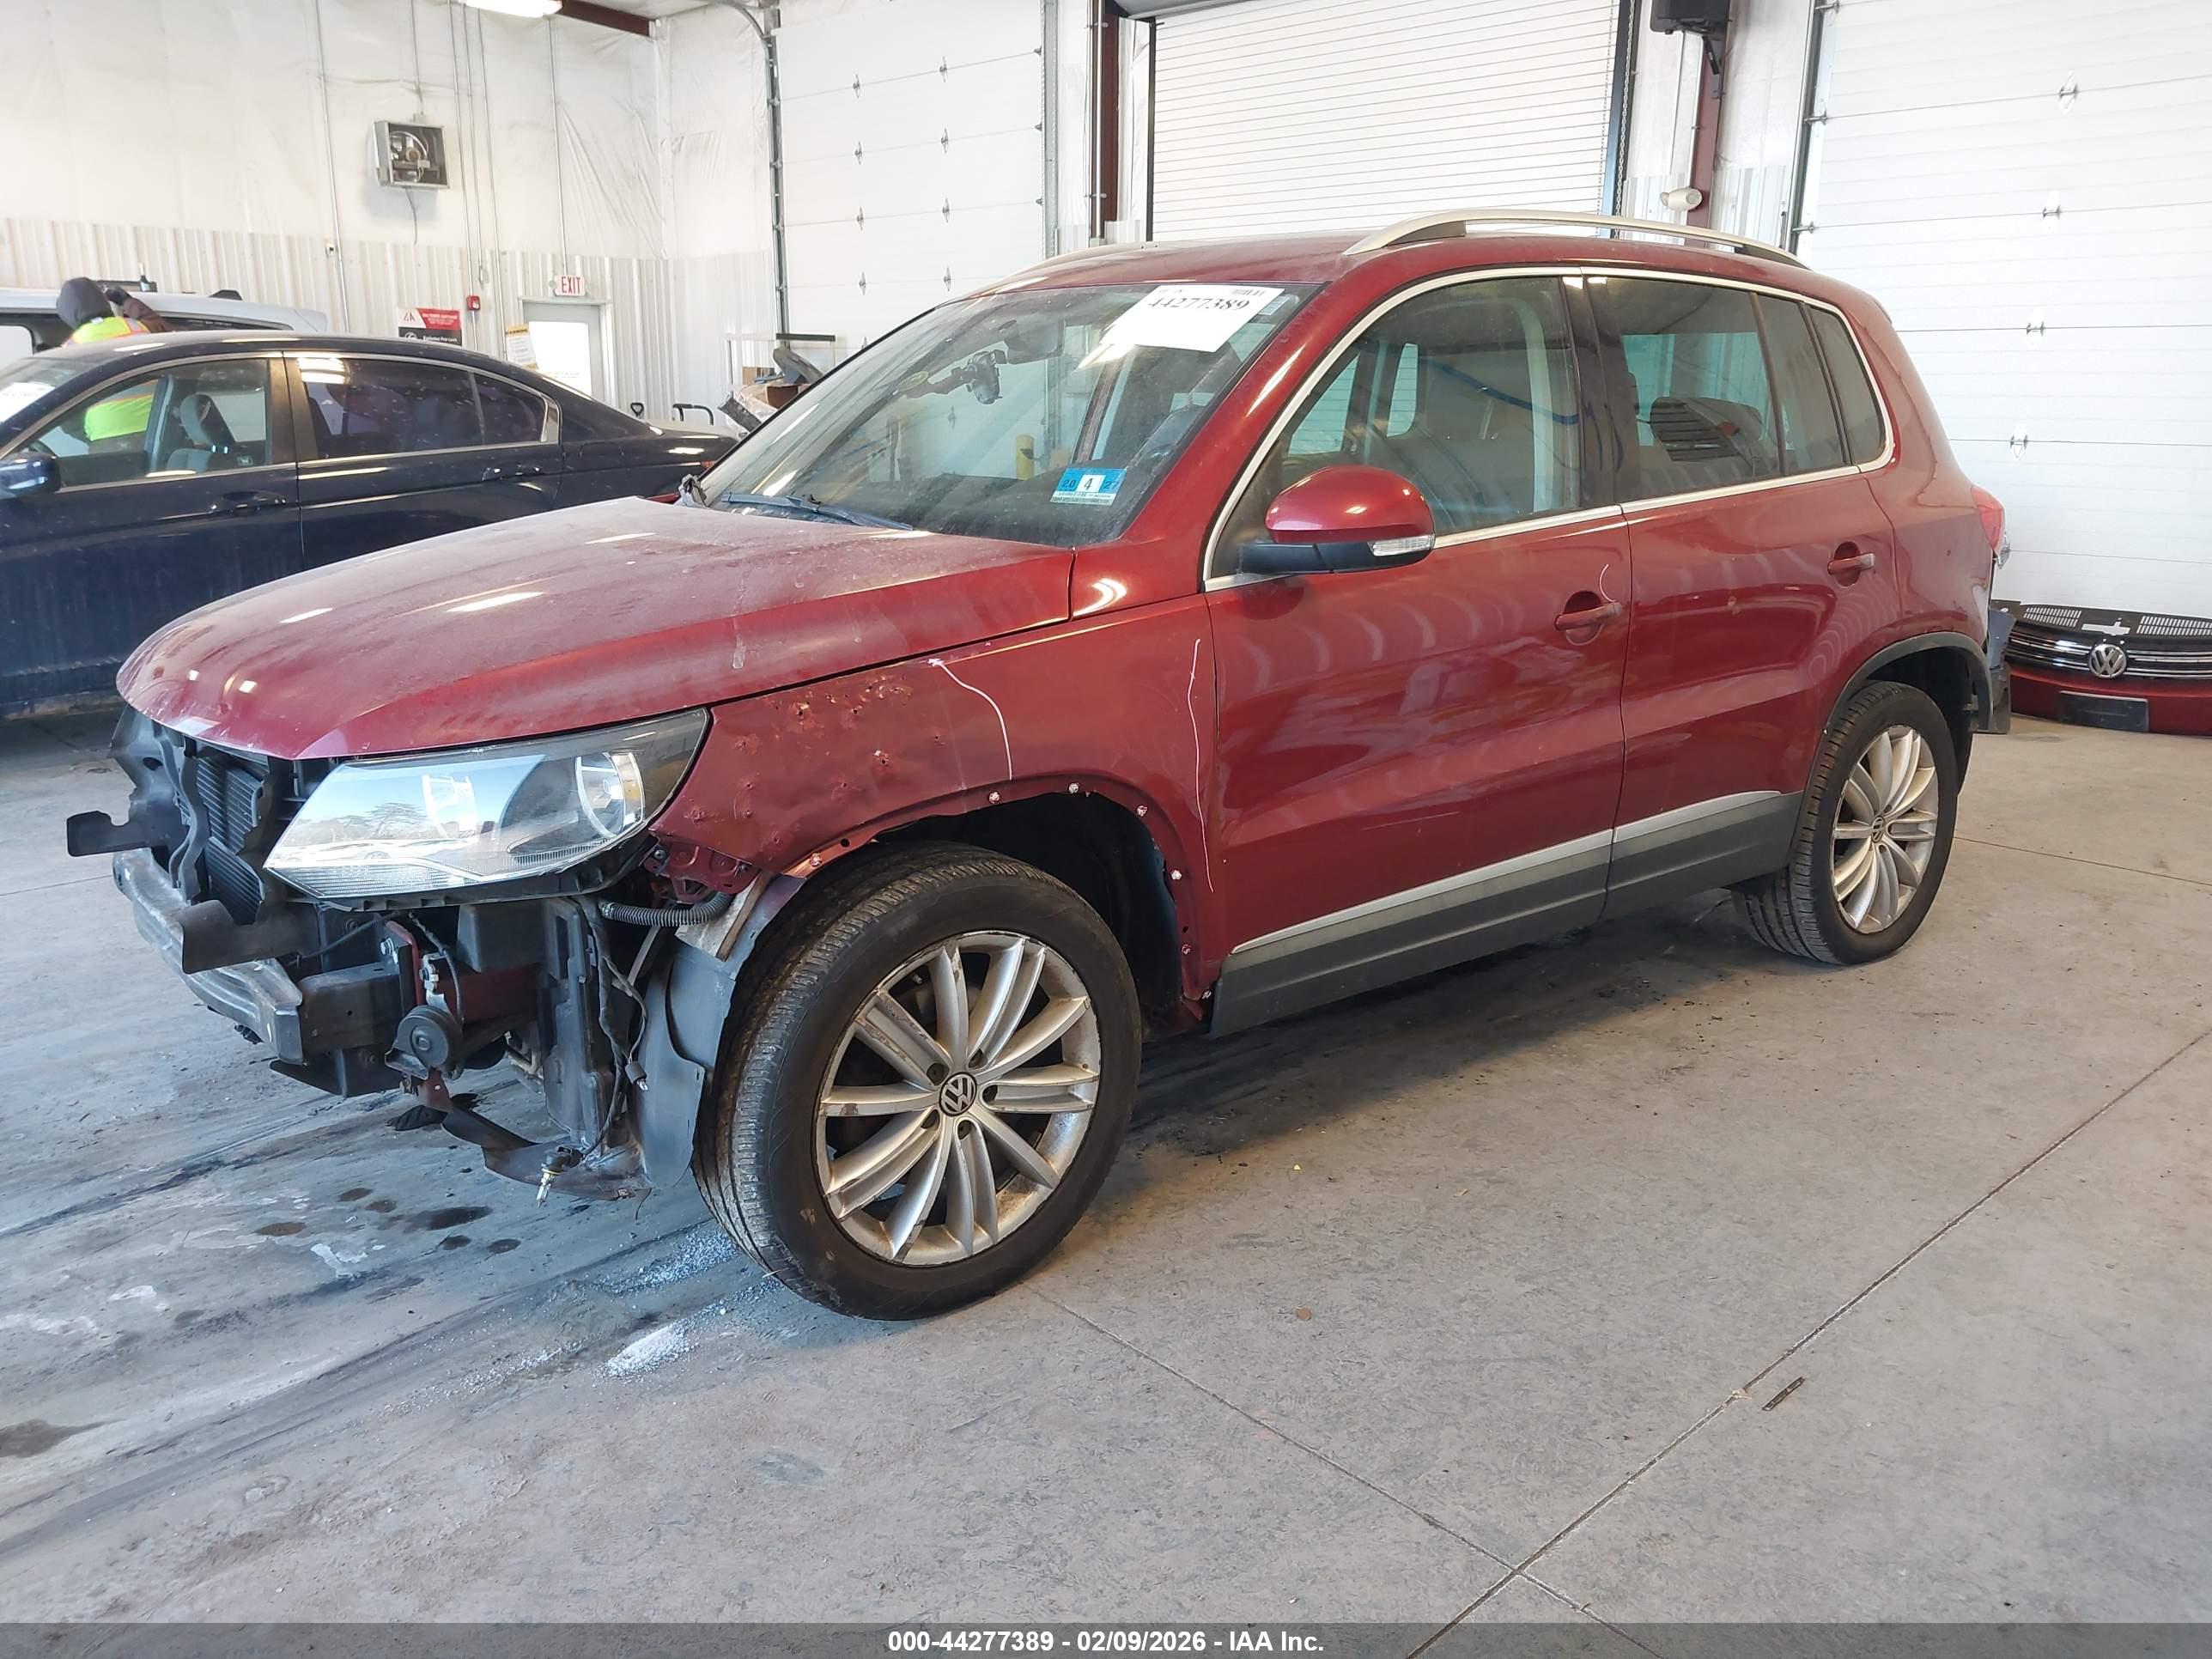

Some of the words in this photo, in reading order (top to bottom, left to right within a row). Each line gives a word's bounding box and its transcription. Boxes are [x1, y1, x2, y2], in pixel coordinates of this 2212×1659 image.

[561, 276, 581, 294] EXIT
[1147, 296, 1251, 310] 44277389
[1060, 479, 1077, 489] 20
[1084, 477, 1094, 490] 4
